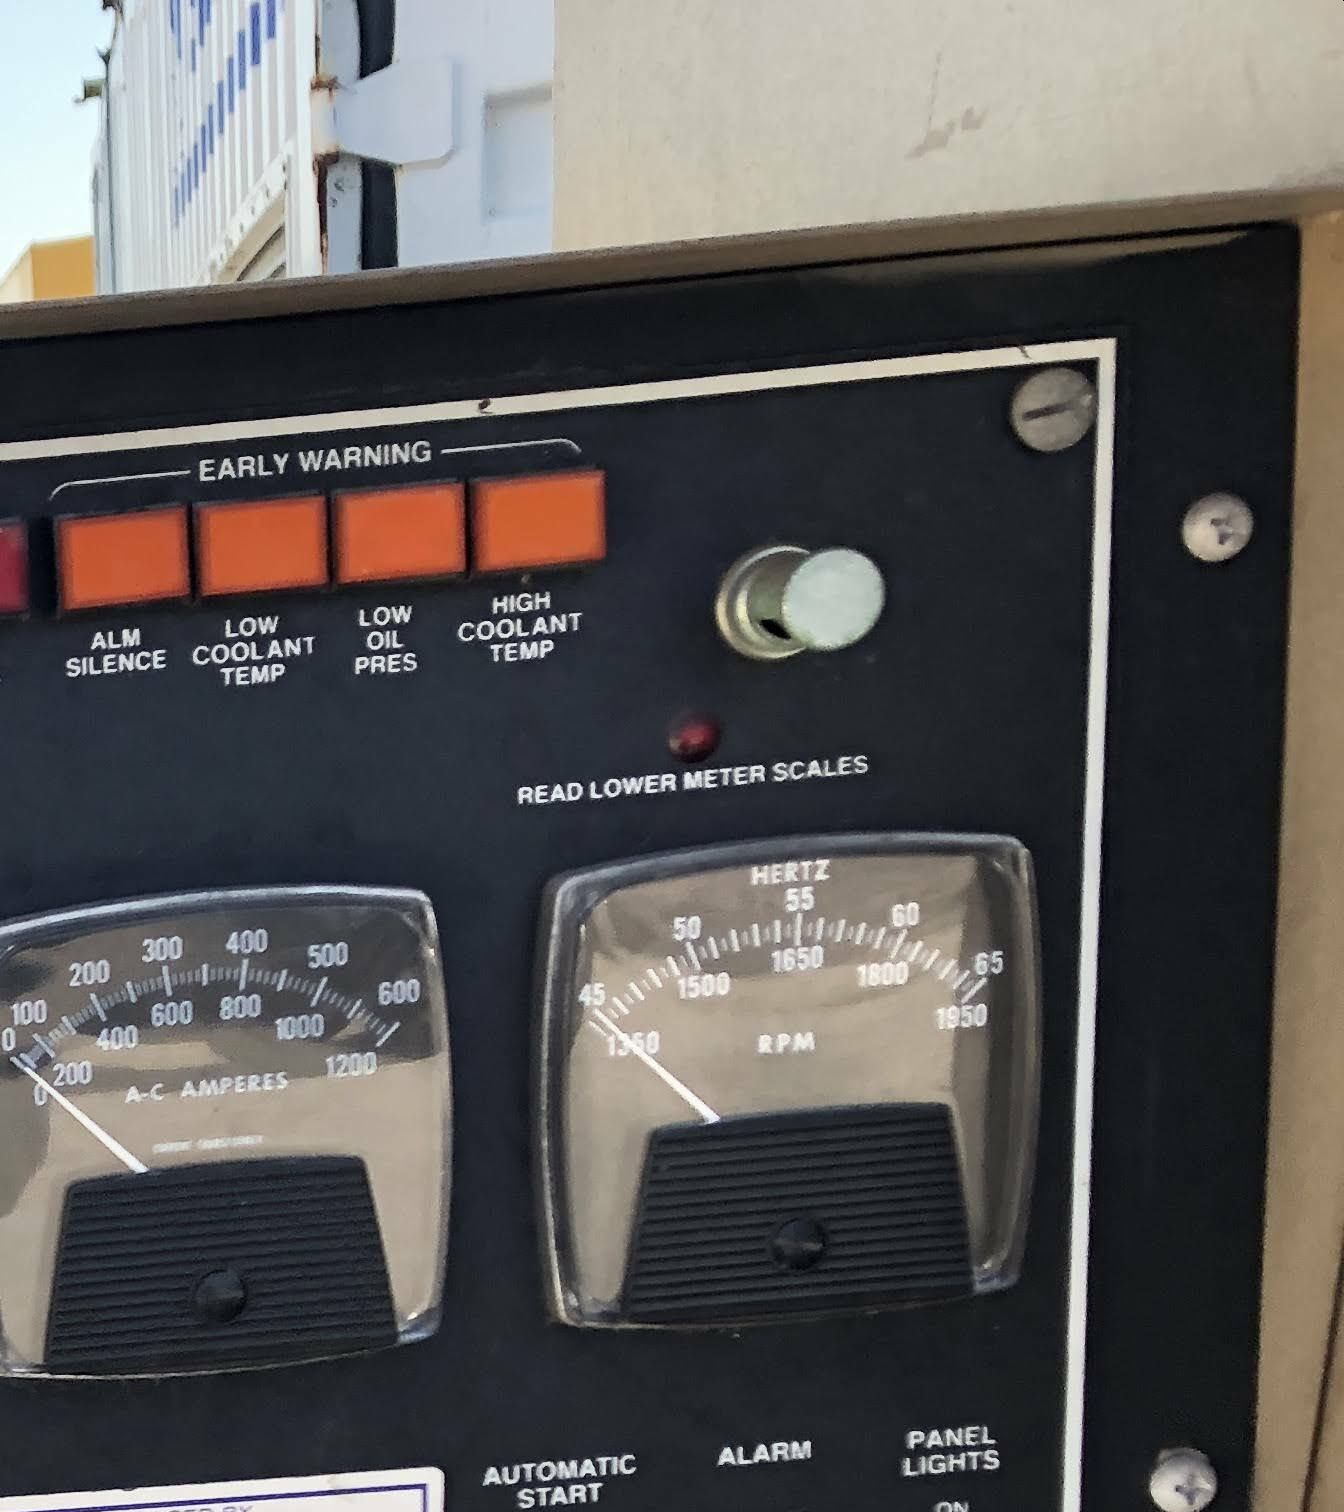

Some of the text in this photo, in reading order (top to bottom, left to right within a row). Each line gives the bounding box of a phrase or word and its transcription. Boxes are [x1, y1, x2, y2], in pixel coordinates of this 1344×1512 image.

[199, 441, 431, 482] EARLY WARNING
[359, 606, 412, 627] LOW
[493, 592, 551, 615] HIGH
[91, 629, 141, 650] ALM
[225, 616, 278, 638] LOW
[457, 612, 583, 642] COOLANT
[193, 636, 315, 666] COOLANT
[367, 631, 405, 650] OIL
[490, 639, 554, 663] TEMP
[65, 649, 167, 678] SILENCE
[220, 663, 286, 686] TEMP
[355, 652, 418, 675] PRES
[518, 755, 868, 805] READ LOWER METER SCALES
[751, 859, 831, 885] HERTZ
[785, 887, 814, 911] 55
[673, 916, 701, 941] 50
[892, 903, 920, 928] 60
[142, 936, 183, 963] 300
[226, 929, 268, 954] 400
[308, 942, 348, 969] 500
[771, 946, 824, 972] 1650
[974, 951, 1003, 977] 65
[69, 961, 111, 987] 200
[678, 972, 730, 999] 1500
[857, 963, 909, 987] 1800
[378, 979, 420, 1006] 600
[579, 982, 606, 1006] 45
[13, 1000, 48, 1027] 100
[151, 1000, 193, 1027] 600
[219, 994, 261, 1020] 800
[936, 1004, 987, 1030] 1950
[1, 1028, 16, 1051] 0
[95, 1025, 138, 1051] 400
[275, 1013, 325, 1041] 1000
[758, 1032, 815, 1053] RPM
[53, 1061, 93, 1086] 200
[326, 1052, 377, 1077] 1200
[125, 1072, 289, 1103] A-C AMPERES
[906, 1426, 996, 1449] PANEL
[718, 1440, 812, 1466] ALARM
[901, 1450, 1000, 1477] LIGHTS
[482, 1455, 637, 1486] AUTOMATIC
[517, 1484, 602, 1509] START
